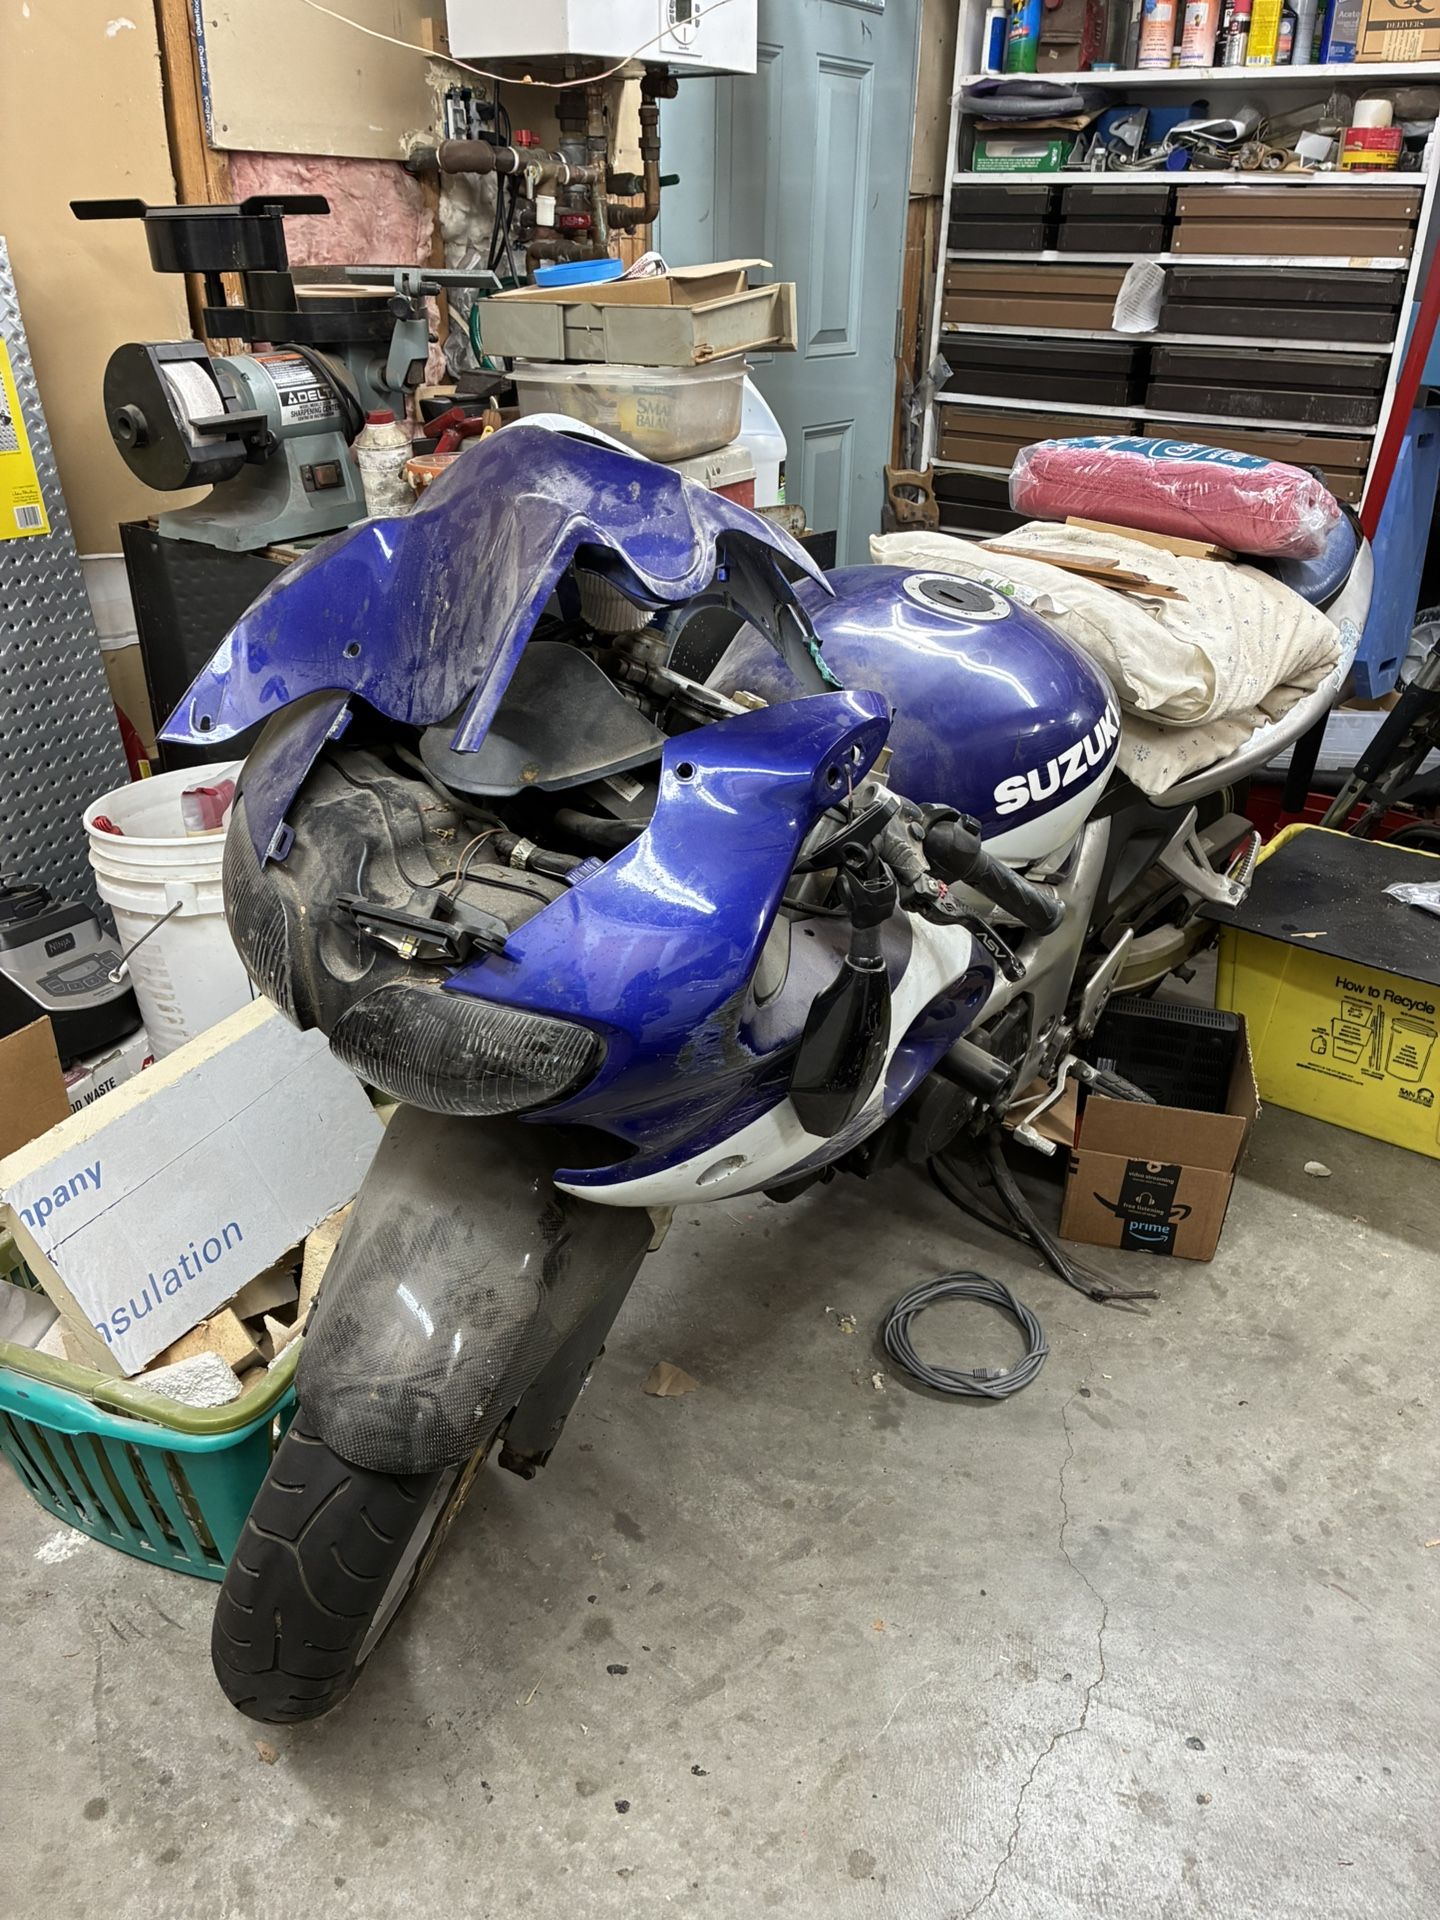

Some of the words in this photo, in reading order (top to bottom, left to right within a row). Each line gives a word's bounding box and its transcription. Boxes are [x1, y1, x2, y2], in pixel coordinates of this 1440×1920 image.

[1385, 20, 1425, 29] DELIVERS
[297, 388, 334, 403] DELT
[290, 406, 322, 418] SHARPENING
[322, 404, 341, 415] CENTE
[993, 699, 1120, 816] SUZUKI
[49, 938, 71, 953] NINJA
[1335, 976, 1366, 994] How
[1368, 985, 1381, 999] to
[1383, 989, 1436, 1015] Recycle
[83, 1076, 117, 1105] WASTE
[1129, 1221, 1170, 1234] prime
